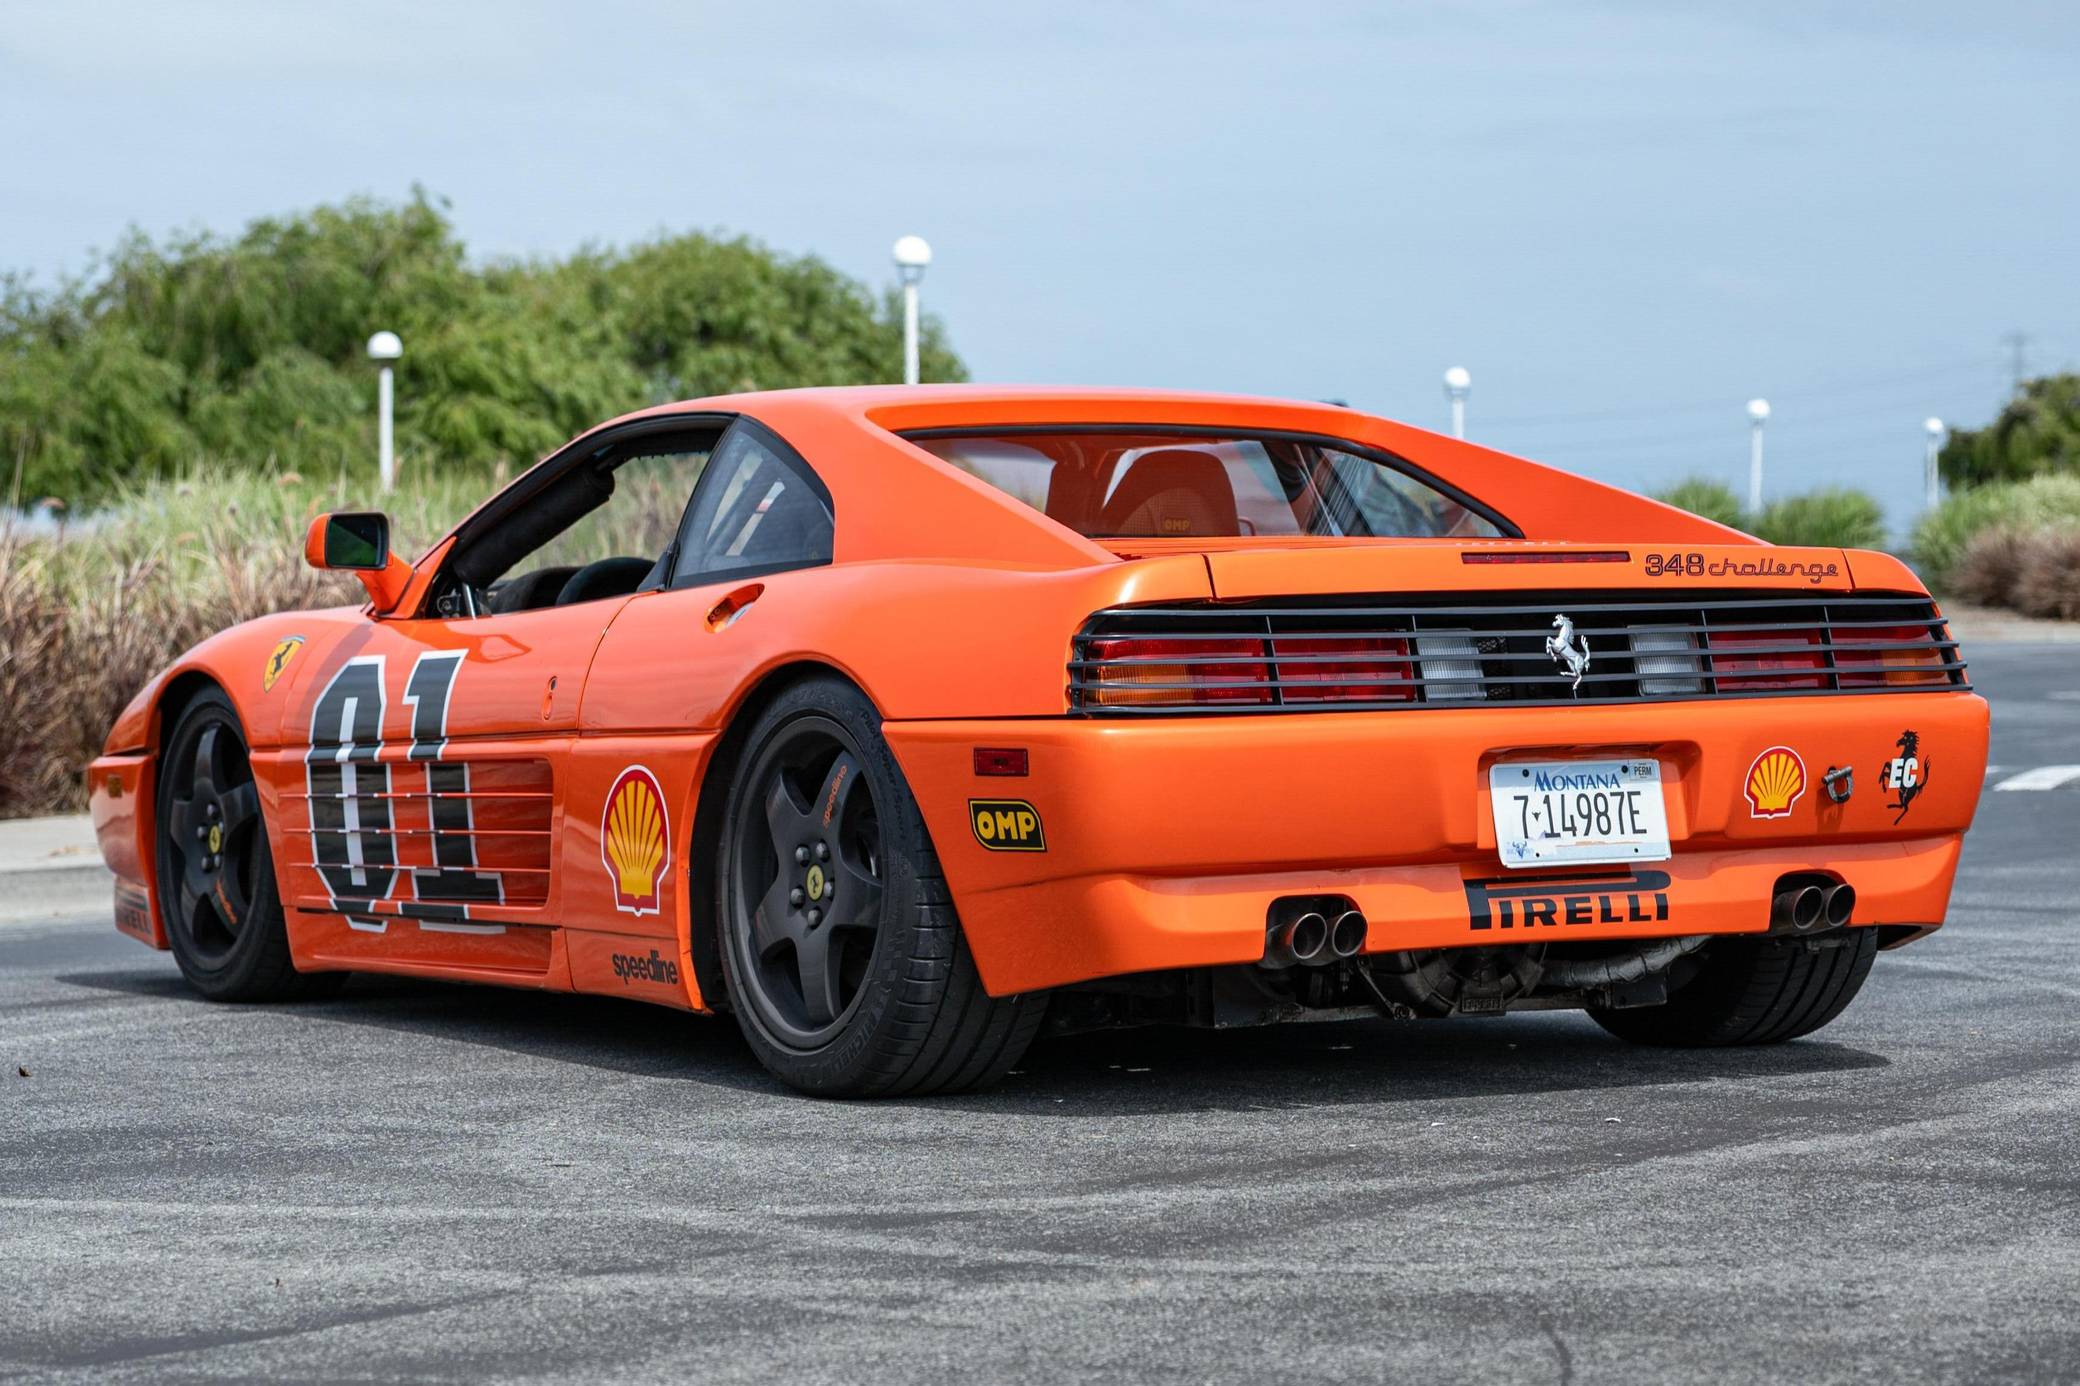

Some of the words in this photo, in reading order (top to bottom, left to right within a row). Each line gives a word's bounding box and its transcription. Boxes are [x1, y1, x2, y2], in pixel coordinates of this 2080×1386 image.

[1645, 553, 1705, 577] 348
[1708, 557, 1839, 584] challenge
[1534, 770, 1621, 792] MONTANA
[1634, 765, 1652, 777] PERM
[1888, 757, 1919, 789] EC
[977, 811, 1036, 840] OMP
[1463, 870, 1672, 931] PIRELLI
[612, 948, 678, 985] speedline
